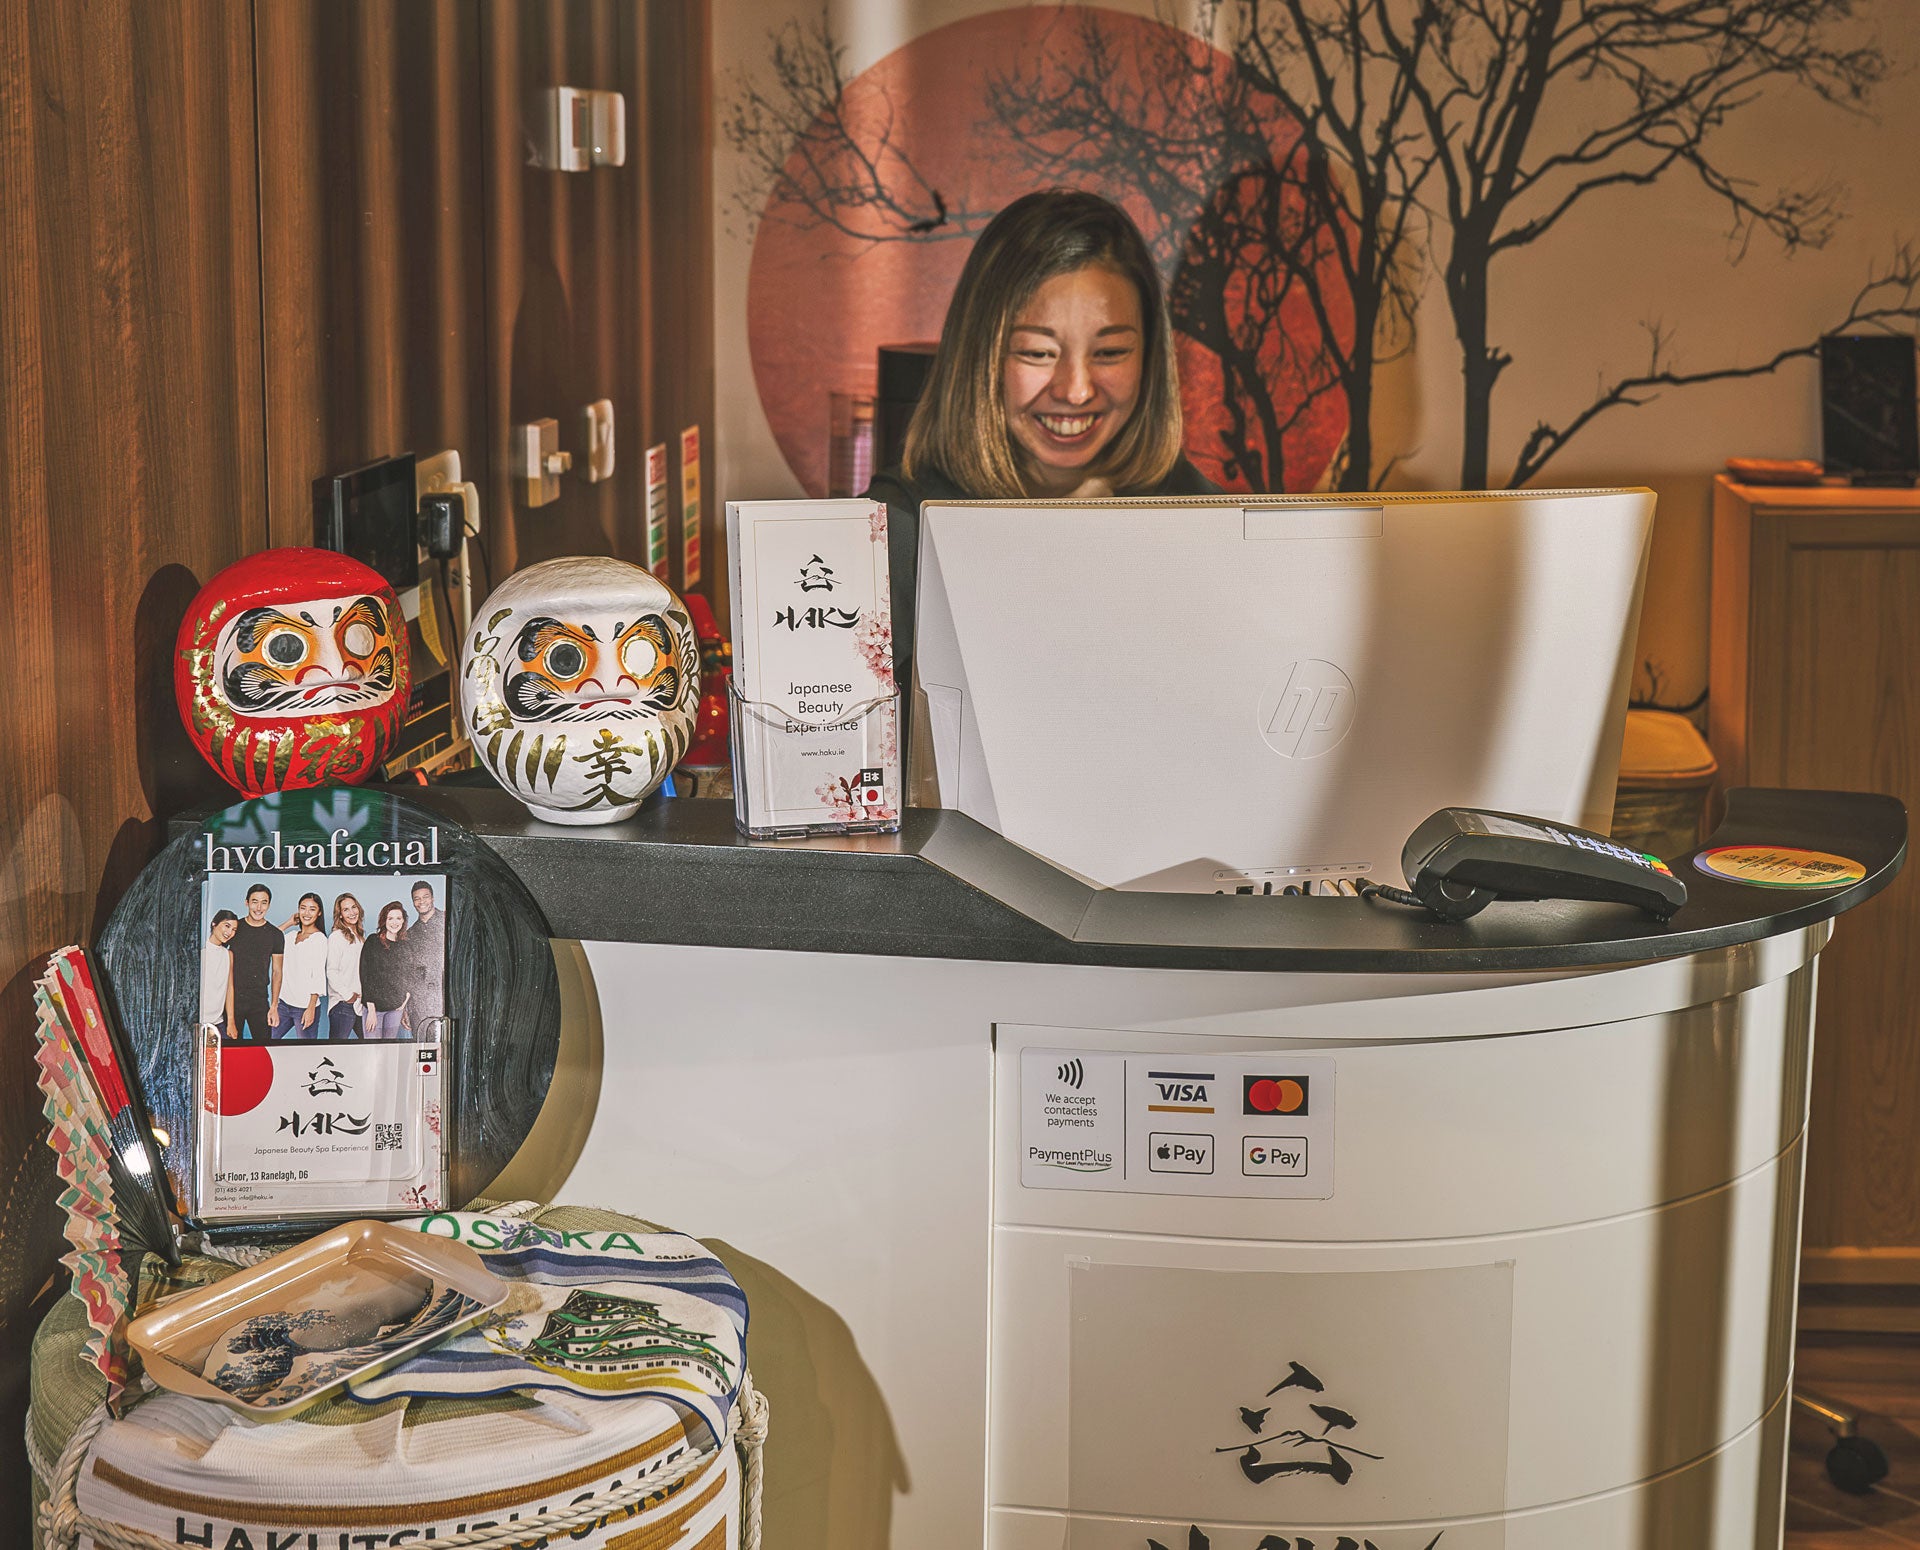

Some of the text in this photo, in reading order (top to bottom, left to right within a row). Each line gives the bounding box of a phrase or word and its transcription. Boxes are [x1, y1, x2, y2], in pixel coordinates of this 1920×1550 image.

[772, 605, 860, 632] HAKU
[787, 682, 852, 697] Japanese
[798, 700, 844, 715] Beauty
[1266, 660, 1348, 759] hp
[785, 719, 859, 736] Experience
[801, 748, 845, 757] www.haku.ie
[863, 771, 880, 783] 日本
[203, 827, 442, 873] hydrafacial
[1045, 1093, 1096, 1106] We accept
[1154, 1083, 1208, 1103] VISA
[1044, 1106, 1098, 1117] contactless
[275, 1110, 372, 1138] HAKU
[1047, 1118, 1095, 1128] payments
[254, 1144, 369, 1156] Japanese Beauty Spa Experience
[1029, 1146, 1113, 1163] PaymentPlus
[1173, 1145, 1206, 1164] Pay
[1271, 1148, 1301, 1168] Pay
[214, 1170, 309, 1182] 1st Floor, 13 Ranelagh, D6
[420, 1214, 645, 1255] OSAKA
